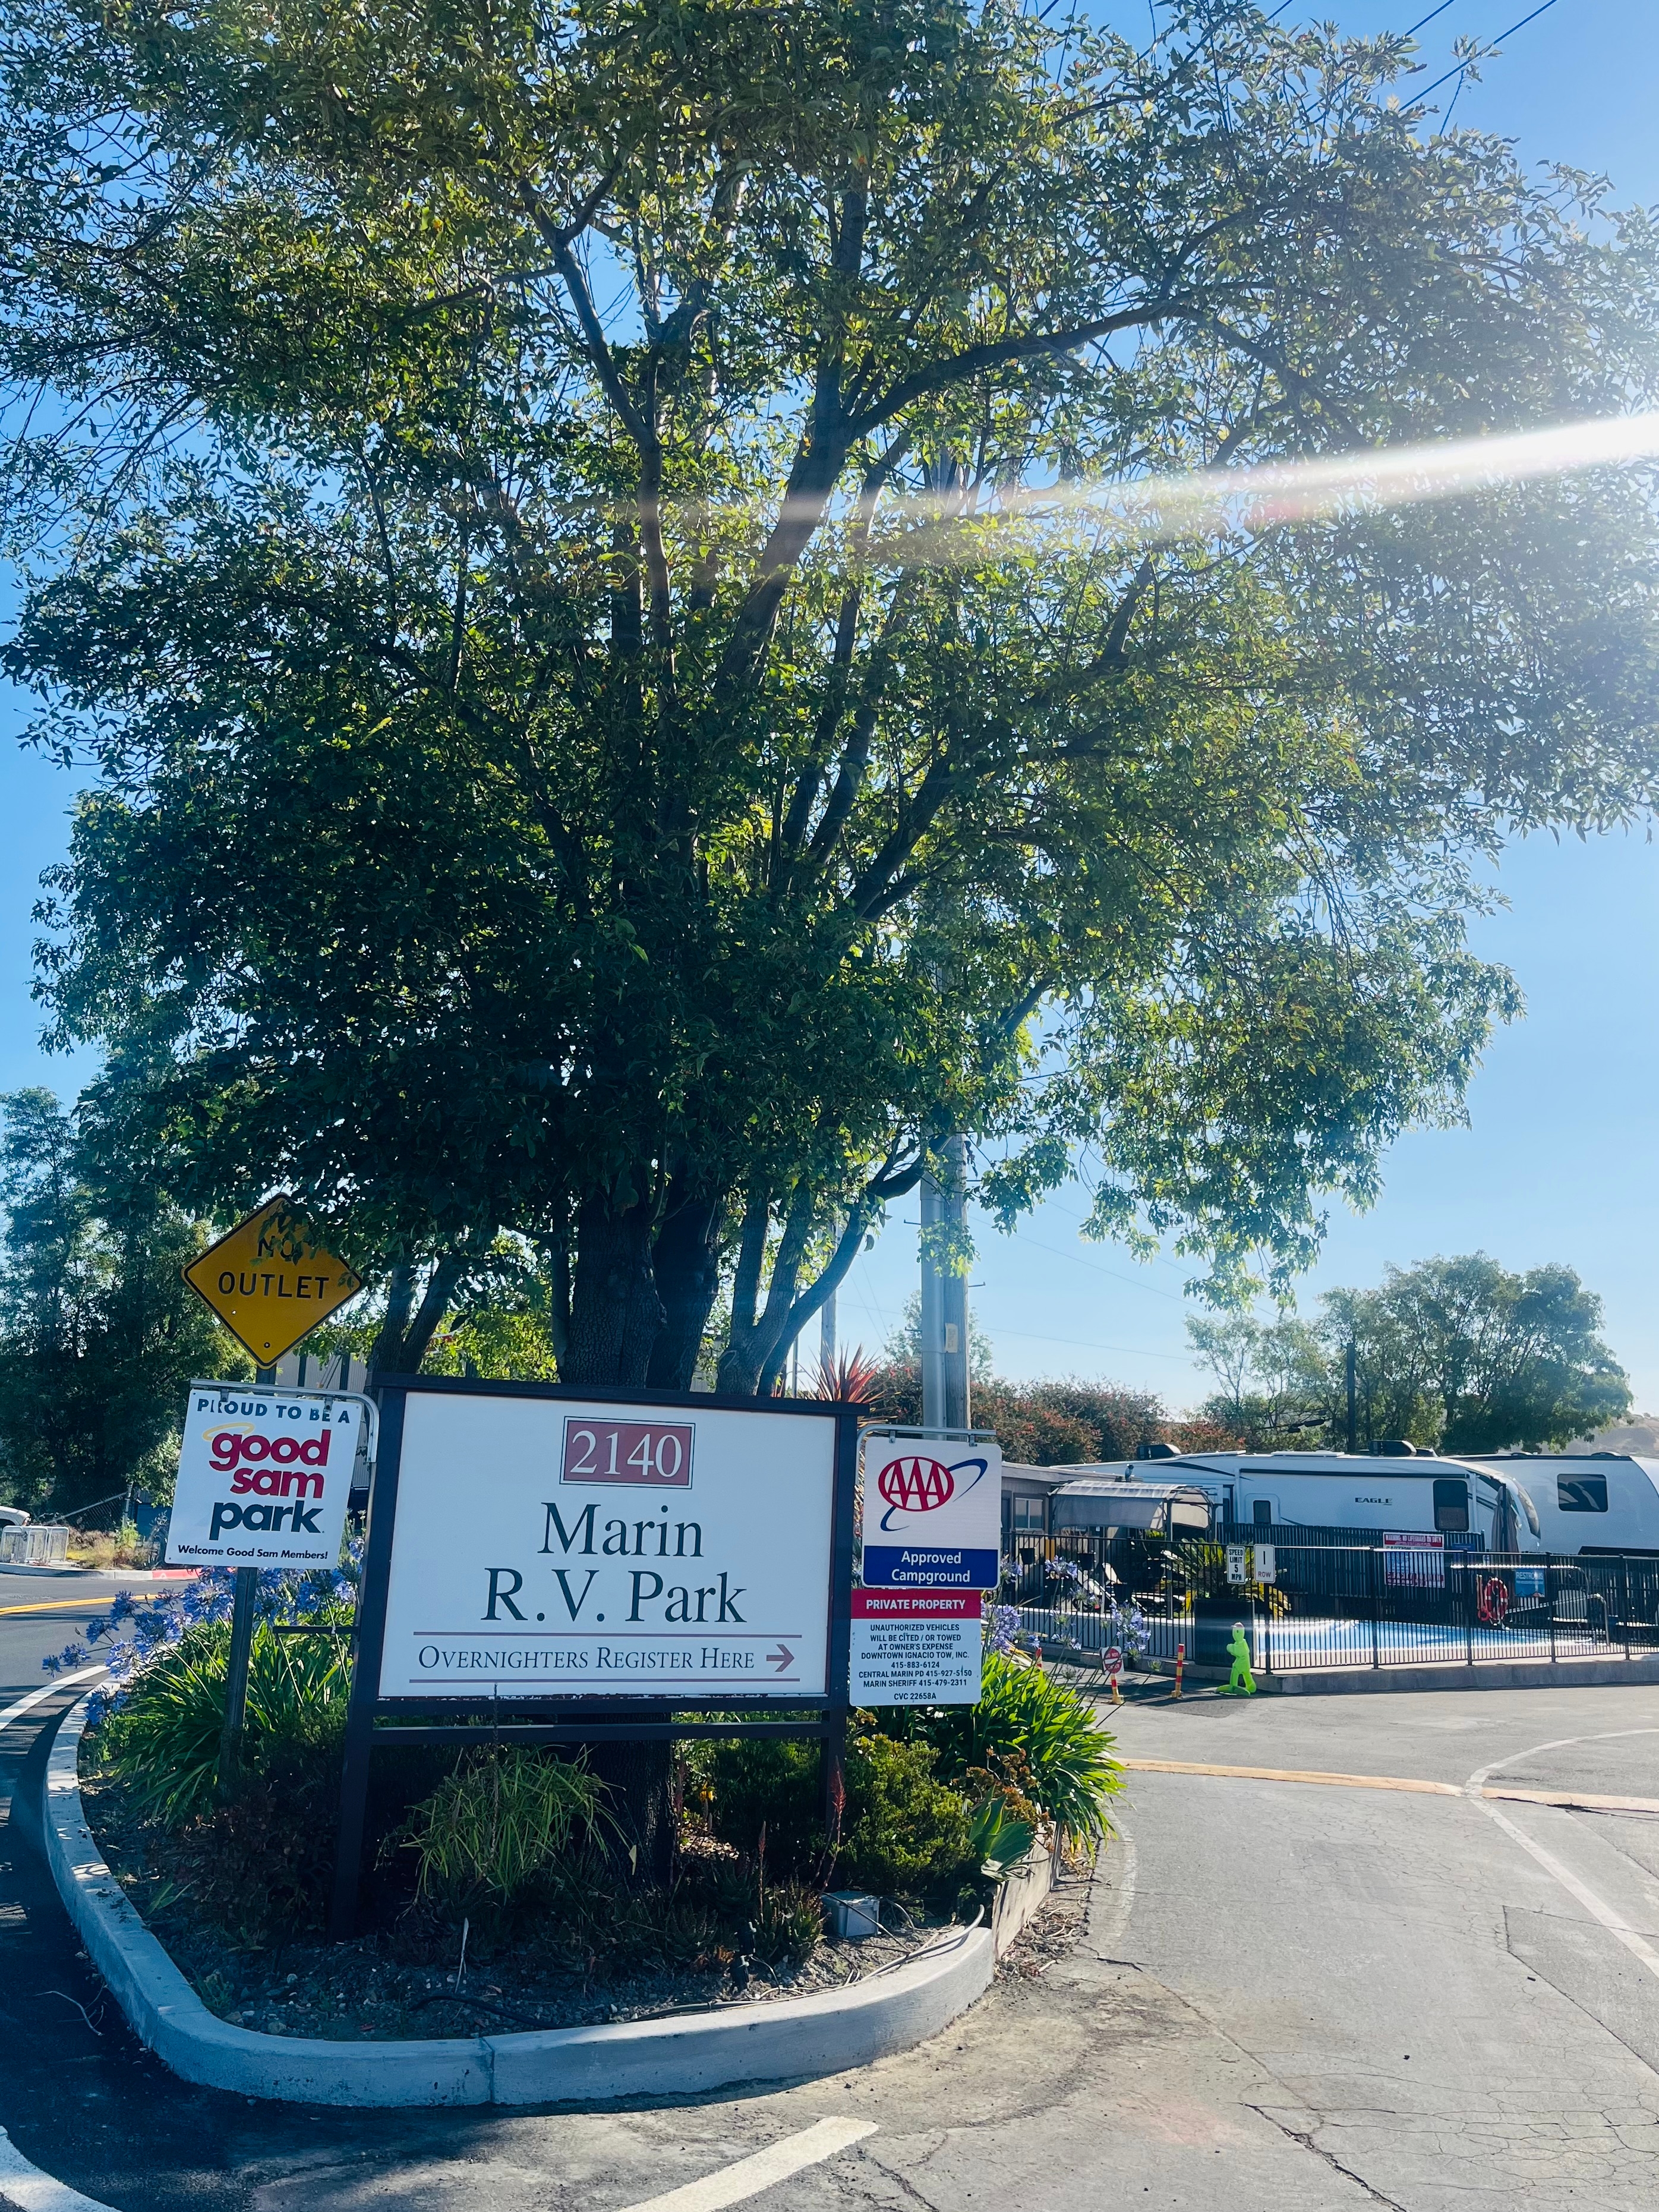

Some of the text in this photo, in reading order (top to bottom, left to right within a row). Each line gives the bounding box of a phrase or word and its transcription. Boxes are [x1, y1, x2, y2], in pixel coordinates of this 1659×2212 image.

[218, 1271, 330, 1300] OUTLET
[276, 1405, 302, 1420] TO
[309, 1407, 330, 1422] BE
[338, 1410, 350, 1424] A
[209, 1429, 331, 1472] good
[569, 1430, 683, 1478] 2140
[230, 1467, 324, 1499] sam
[882, 1457, 950, 1511] AAA
[209, 1499, 324, 1541] park
[537, 1502, 705, 1558] Marin
[178, 1544, 328, 1559] Welcome Good Sam Members!
[901, 1551, 962, 1566] Approved
[891, 1569, 971, 1585] Campground
[1235, 1564, 1238, 1573] 5
[1516, 1571, 1543, 1580] RESTROS
[481, 1567, 748, 1624] R.V. Park
[866, 1599, 966, 1611] PRIVATE PROPERTY
[418, 1645, 755, 1670] OVERNIGHTERS REGISTER HERE
